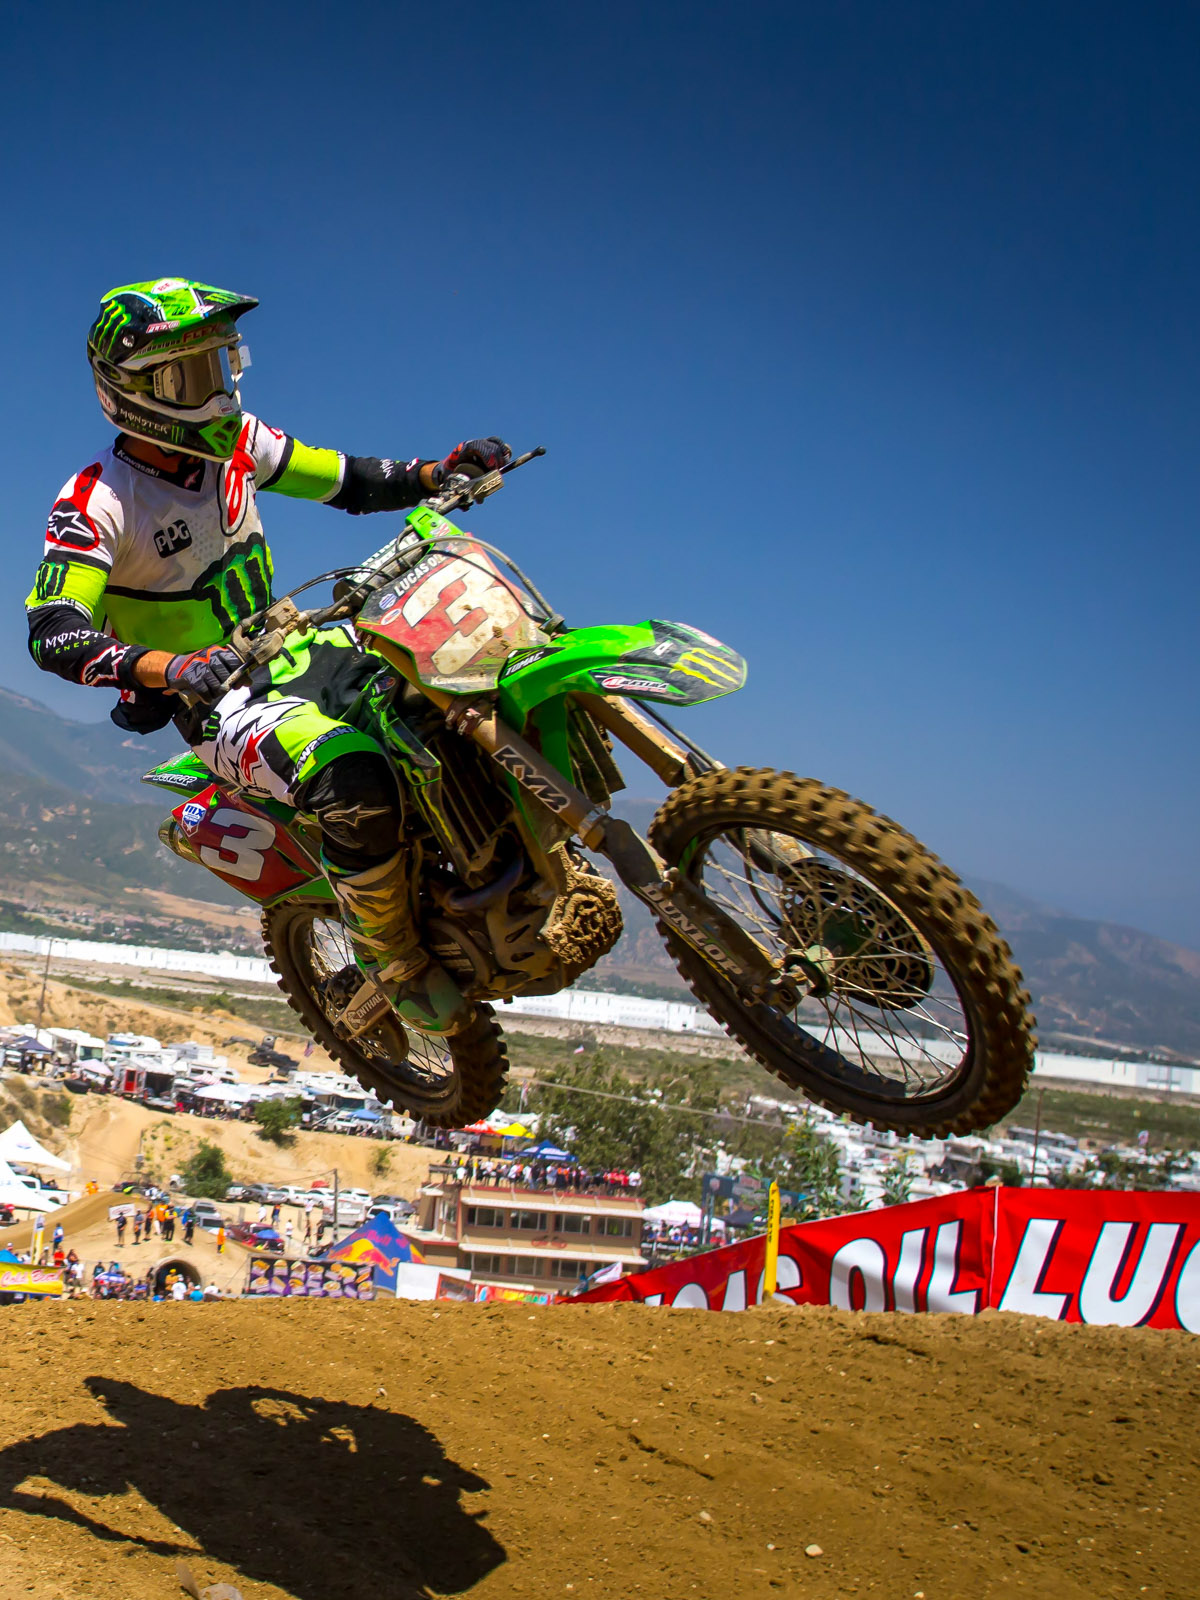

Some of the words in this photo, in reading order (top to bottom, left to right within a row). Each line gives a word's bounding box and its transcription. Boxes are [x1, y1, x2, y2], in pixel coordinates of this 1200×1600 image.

[117, 450, 161, 478] Kawasaki
[155, 523, 192, 553] PPG
[394, 560, 430, 597] LUCAS
[402, 552, 521, 675] 3
[505, 651, 545, 676] TOMAC
[200, 807, 276, 881] 3
[639, 882, 744, 975] DUNLOP
[830, 1218, 982, 1315] OIL
